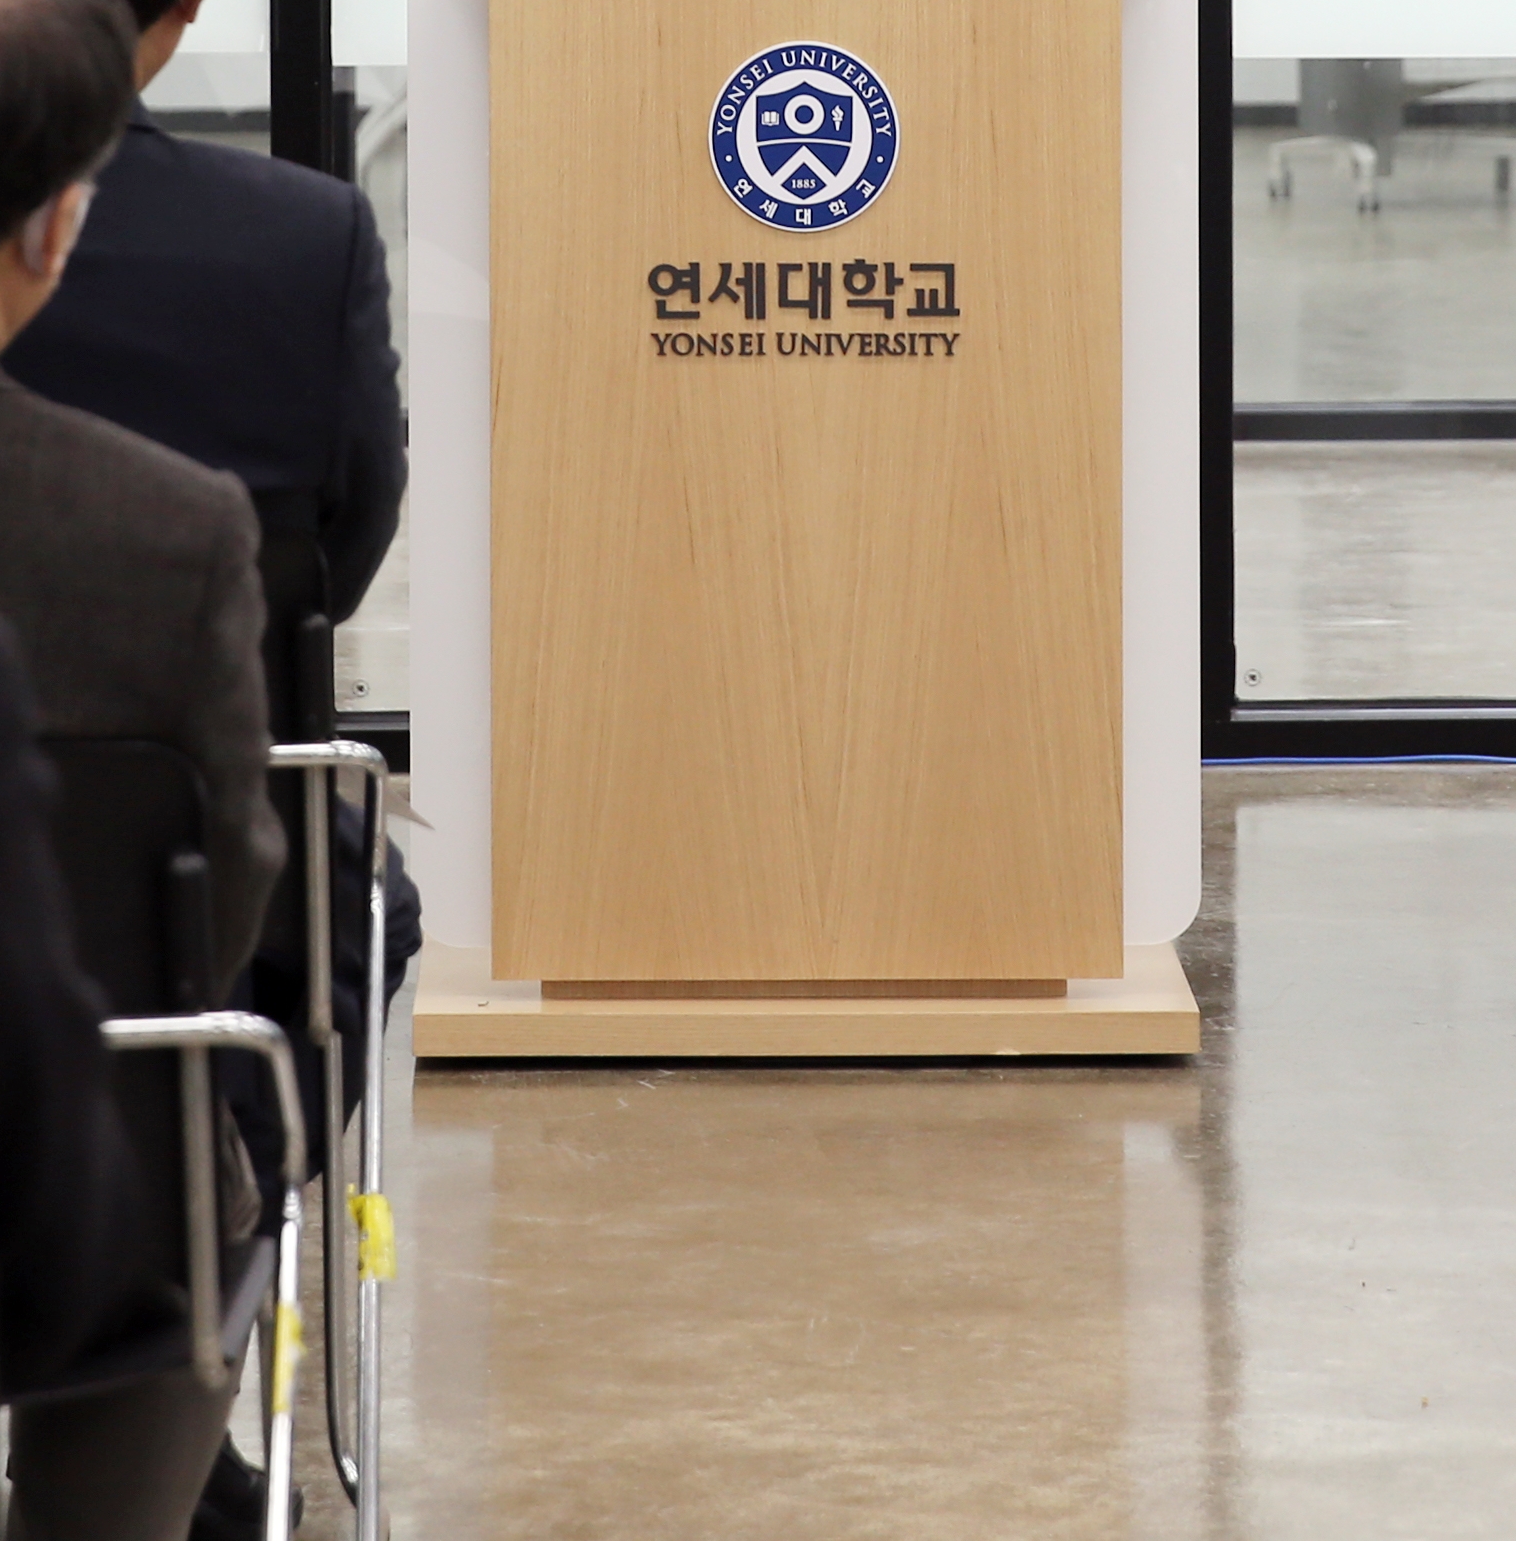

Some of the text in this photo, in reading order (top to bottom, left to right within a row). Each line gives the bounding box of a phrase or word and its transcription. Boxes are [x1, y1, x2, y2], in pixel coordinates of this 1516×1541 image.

[716, 49, 892, 138] YONSEI UNIVERSITY
[732, 177, 877, 226] 연세대학교
[790, 179, 817, 189] 1885
[646, 258, 962, 321] 연세대학교
[650, 331, 962, 358] YONSEI UNIVERSITY
